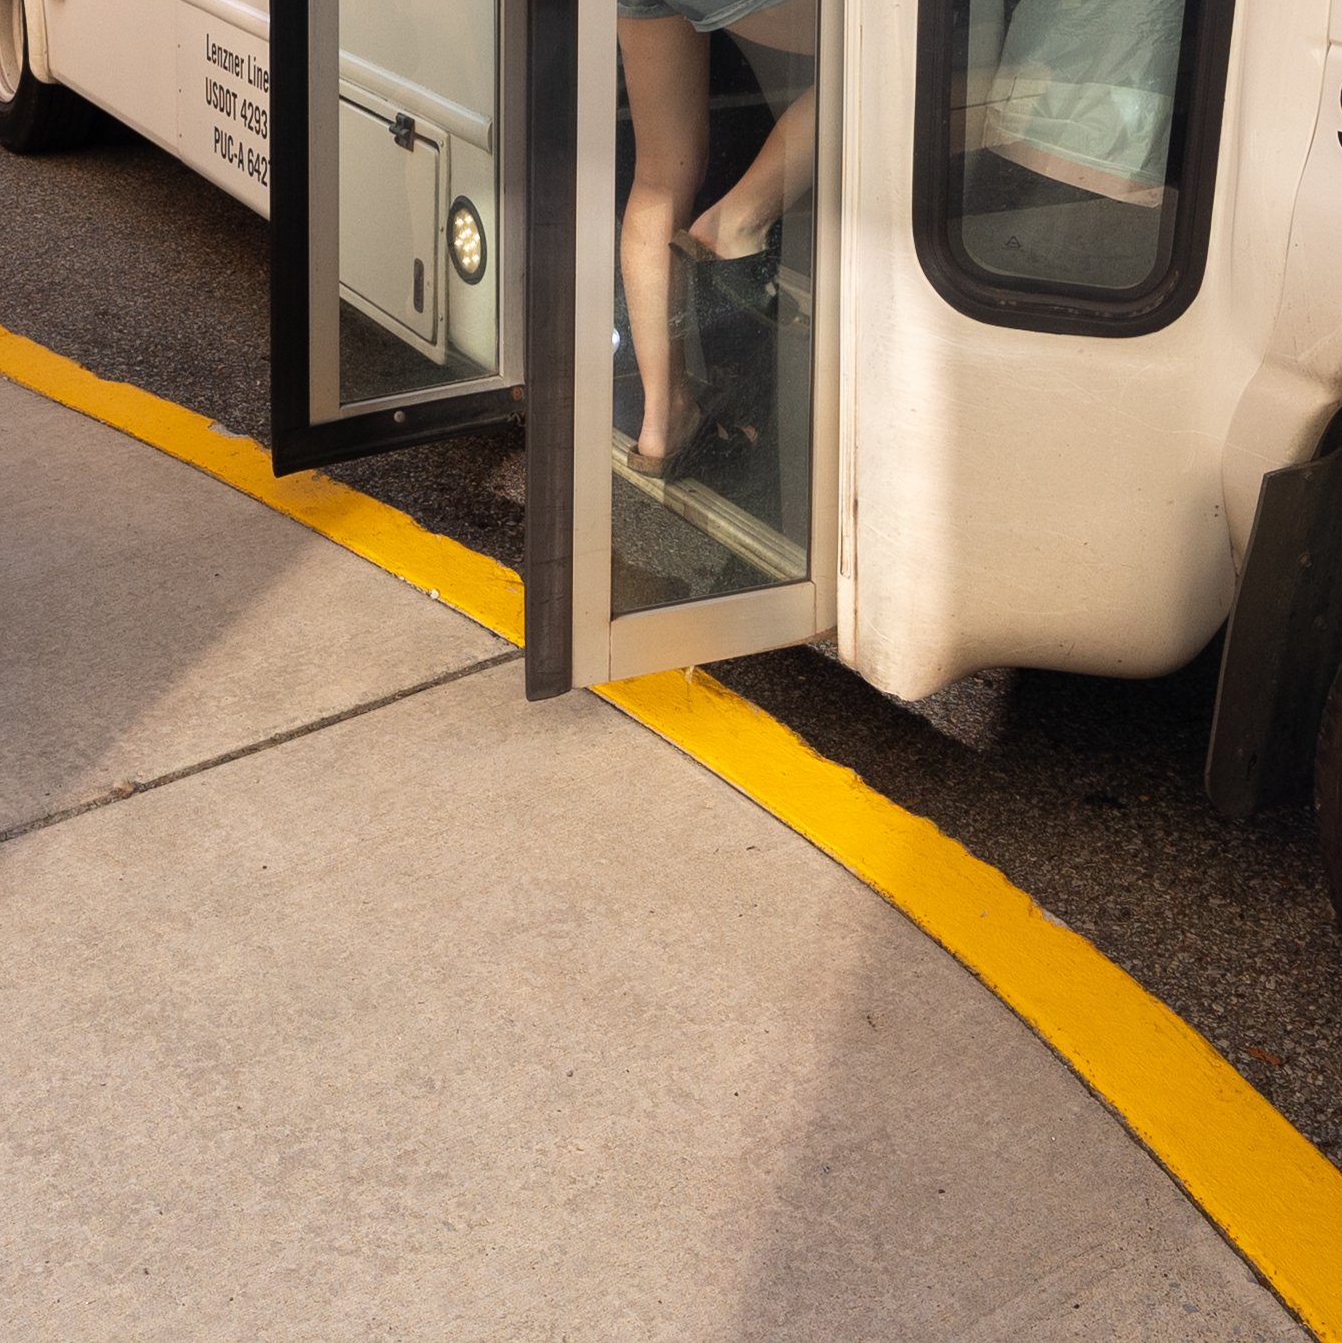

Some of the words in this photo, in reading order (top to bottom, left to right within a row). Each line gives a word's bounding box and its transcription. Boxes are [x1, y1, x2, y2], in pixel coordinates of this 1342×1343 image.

[206, 33, 245, 80] Lenzner
[205, 76, 238, 121] USDOT
[240, 98, 268, 140] 4293
[214, 125, 245, 172] PUC-A
[247, 147, 270, 187] 642
